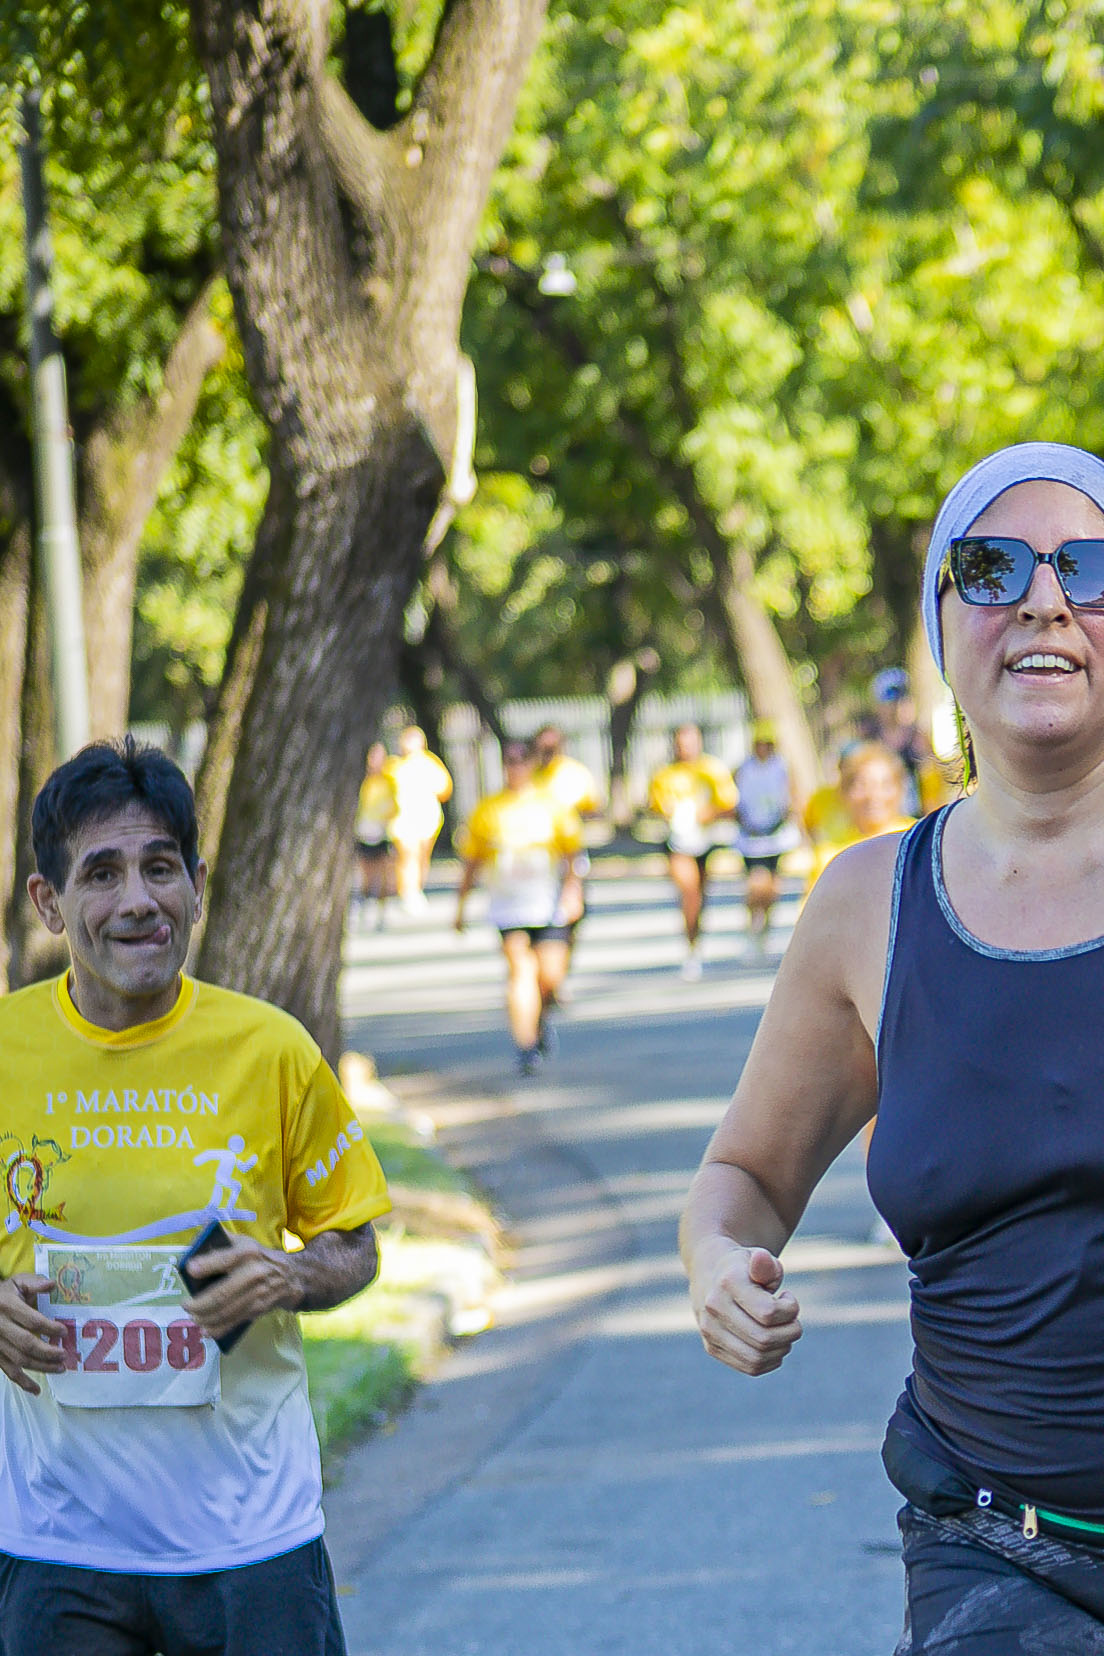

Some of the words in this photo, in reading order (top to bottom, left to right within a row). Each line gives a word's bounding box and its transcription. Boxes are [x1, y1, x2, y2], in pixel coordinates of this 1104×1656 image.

[75, 1085, 219, 1116] MARATÓN
[70, 1125, 196, 1149] DORADA
[305, 1120, 364, 1187] MARS
